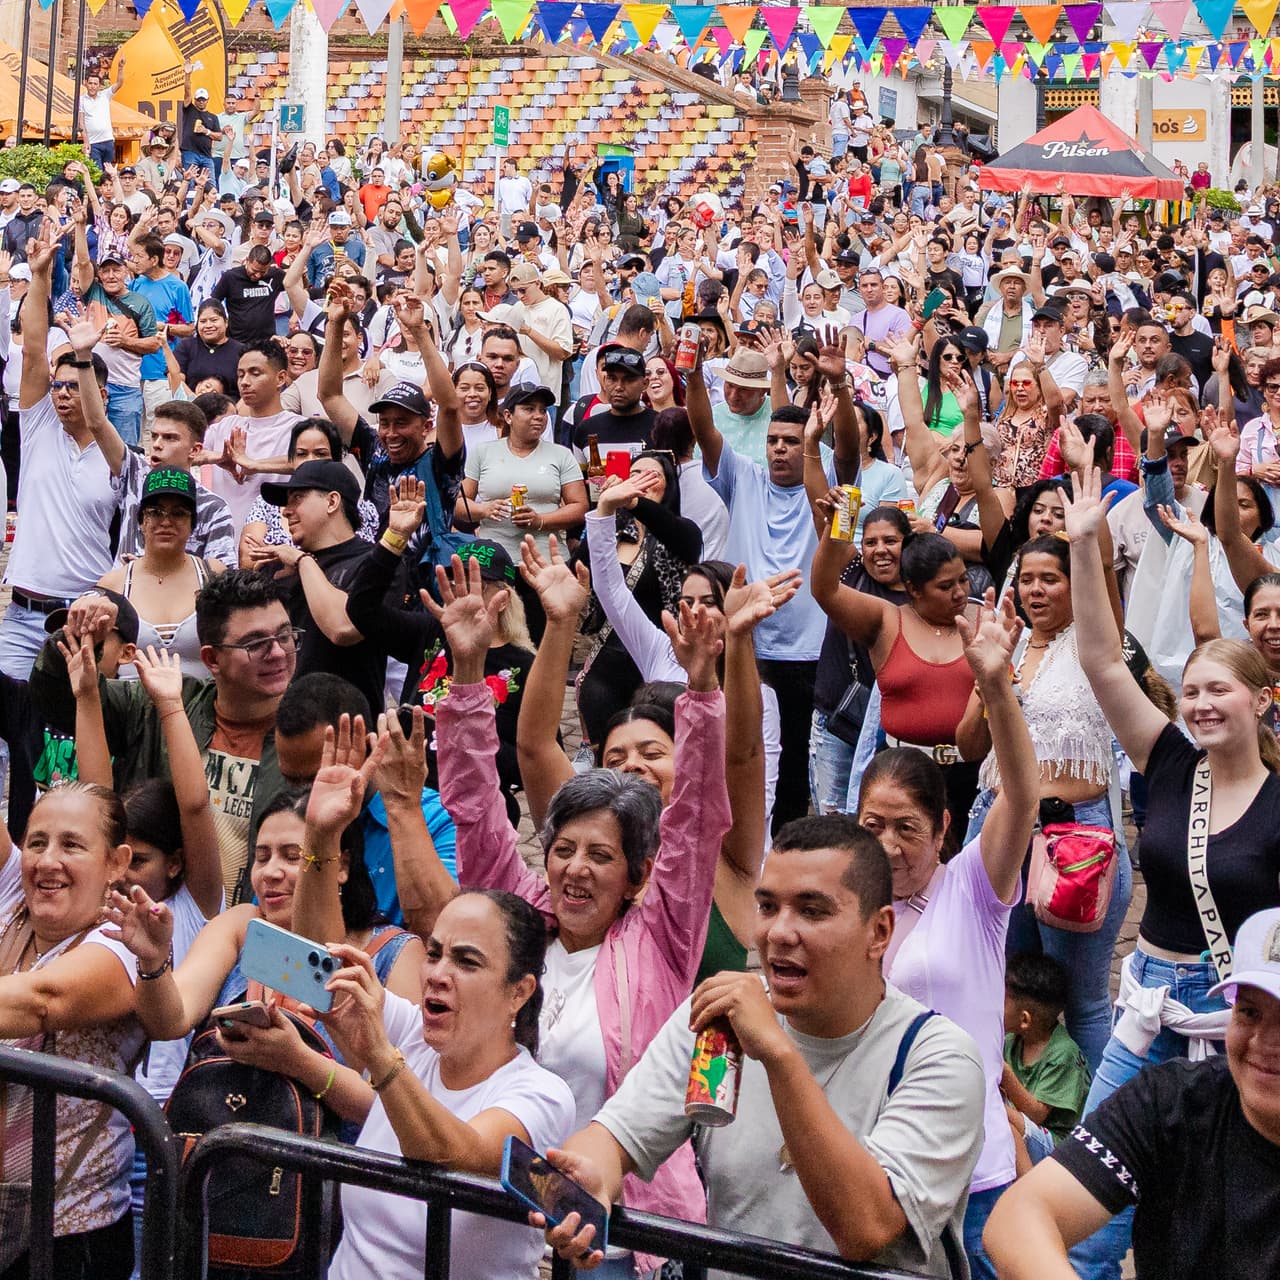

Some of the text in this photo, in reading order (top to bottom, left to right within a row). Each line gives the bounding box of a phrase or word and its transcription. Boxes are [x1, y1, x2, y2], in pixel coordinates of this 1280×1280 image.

[289, 106, 297, 120] P
[1042, 141, 1110, 159] Pilsen
[243, 287, 269, 298] PUMA
[167, 470, 188, 480] LAS
[148, 479, 188, 491] QUE SEA
[470, 543, 496, 557] LAS
[222, 797, 252, 819] LEGE
